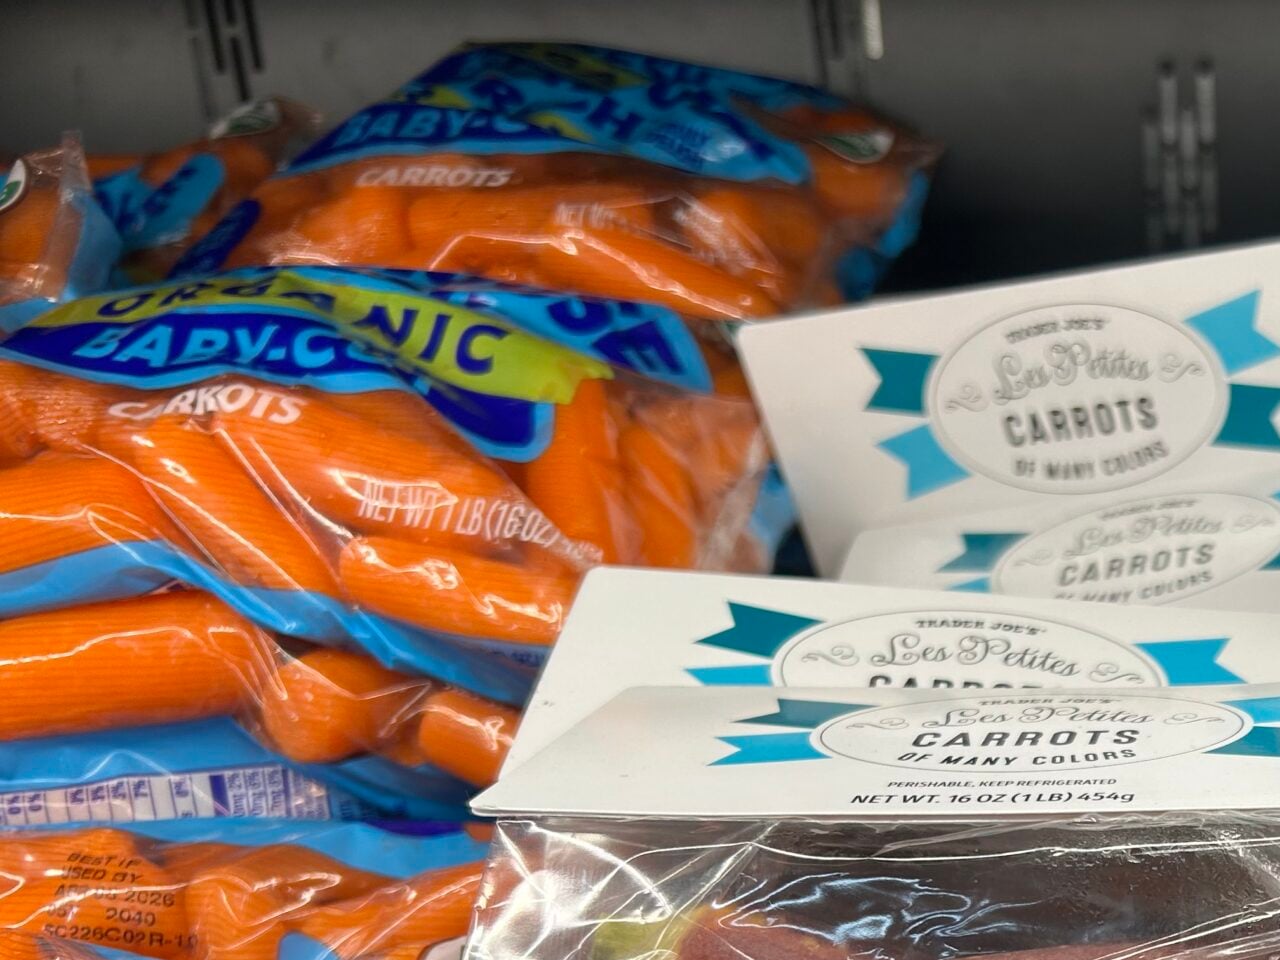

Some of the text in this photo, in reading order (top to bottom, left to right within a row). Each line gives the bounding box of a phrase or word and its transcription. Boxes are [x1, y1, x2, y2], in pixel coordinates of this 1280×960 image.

[355, 165, 519, 188] CARROTS
[1003, 397, 1159, 447] CARROTS
[359, 481, 401, 523] NET
[455, 498, 486, 535] LB
[1057, 543, 1217, 588] CARROTS
[1139, 571, 1213, 599] COLORS
[915, 619, 1041, 636] TRADER JOE'S
[872, 632, 1082, 678] Les Petites
[922, 706, 1154, 730] Les Petites
[911, 729, 1140, 748] CARROTS
[897, 749, 1138, 767] OF MANY COLORS
[887, 777, 1118, 789] PERISHABLE, KEEP REFRIGERATED
[850, 791, 1136, 805] NET WT. 16 OZ (1 LB) 454g
[66, 852, 142, 869] BEST IF
[61, 865, 144, 883] USED BY
[124, 890, 176, 907] 2026
[104, 907, 156, 927] 2040
